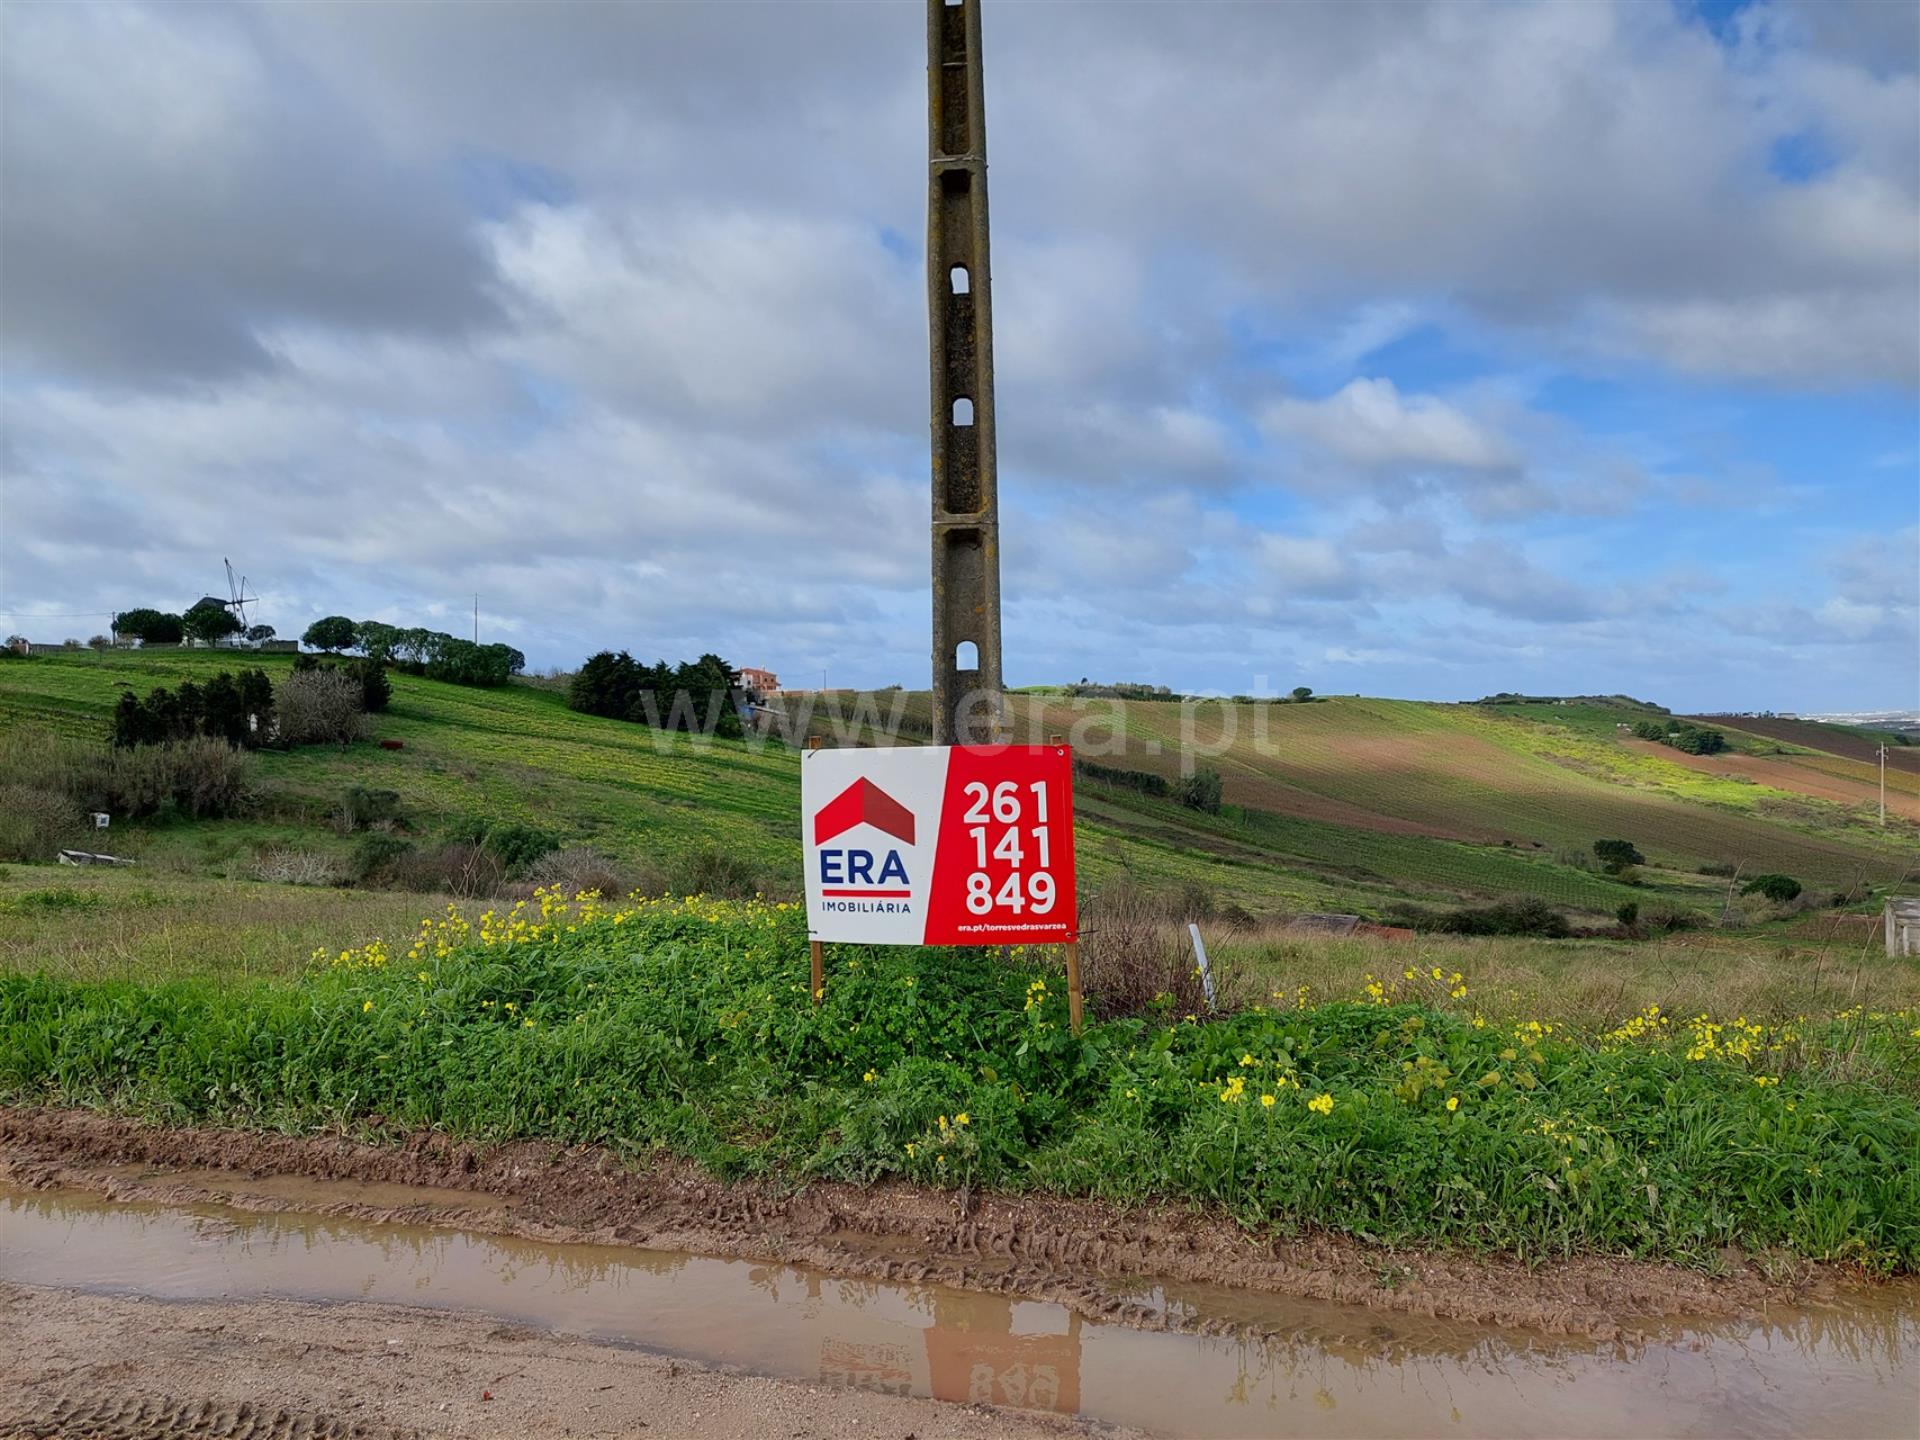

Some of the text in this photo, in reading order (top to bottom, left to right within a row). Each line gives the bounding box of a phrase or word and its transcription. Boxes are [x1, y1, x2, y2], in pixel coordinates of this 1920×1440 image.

[963, 780, 1049, 824] 261
[820, 849, 911, 885] ERA
[969, 826, 1050, 869] 141
[821, 900, 912, 914] IMOBILIÁRIA
[966, 871, 1057, 916] 849
[957, 923, 1067, 933] era.pt/torresvedrasvarzea
